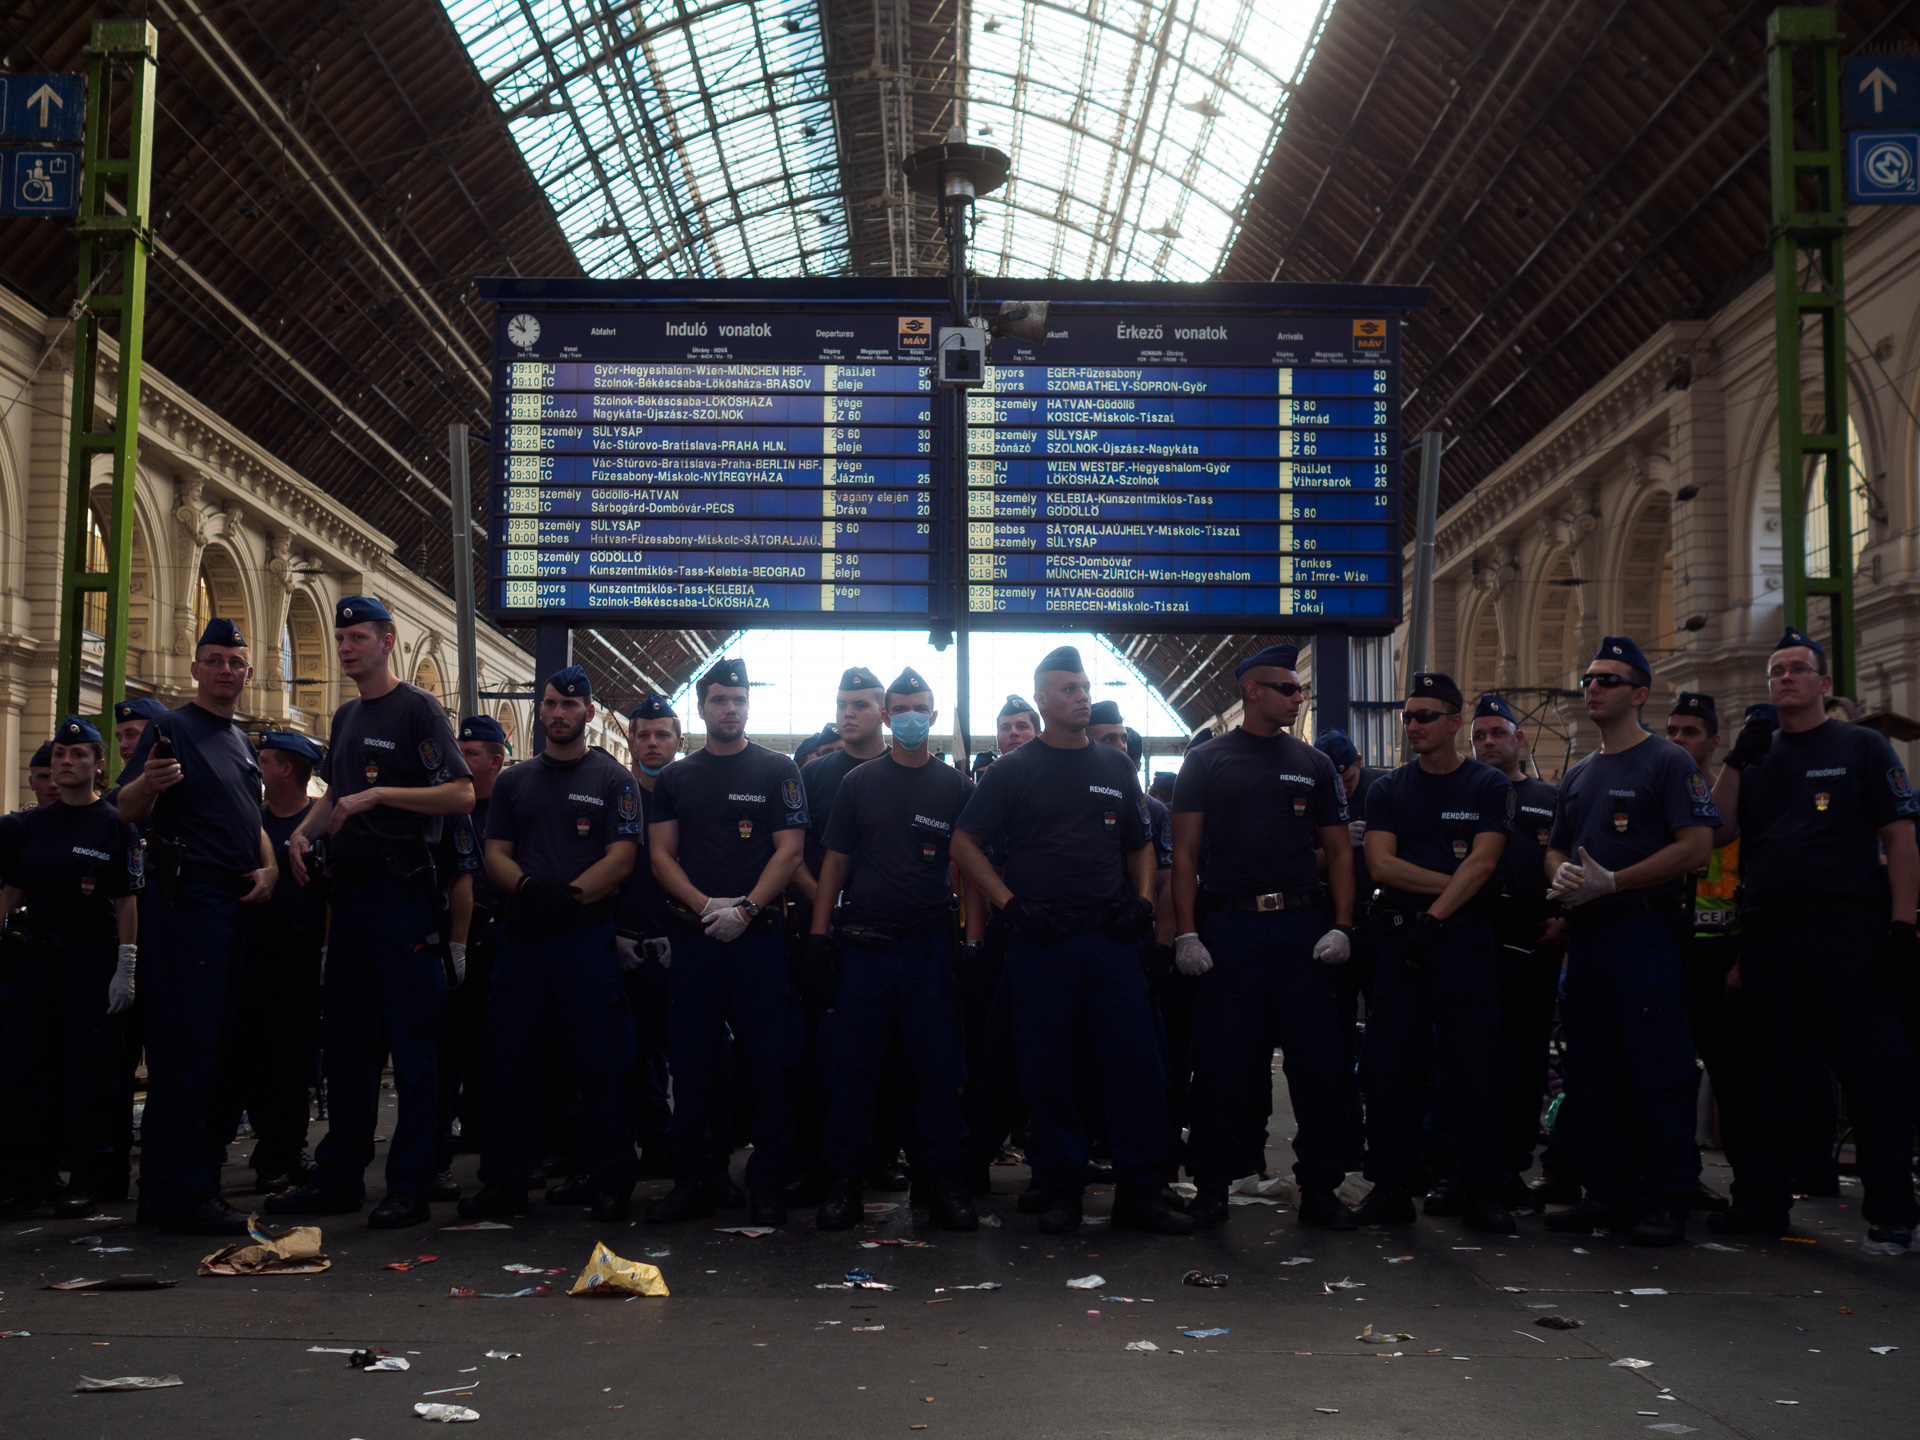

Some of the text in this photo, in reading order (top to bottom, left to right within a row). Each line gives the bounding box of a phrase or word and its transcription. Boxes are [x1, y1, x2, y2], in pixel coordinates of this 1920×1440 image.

[590, 328, 616, 336] Abfahrt
[666, 321, 771, 337] Induló vonatok
[816, 329, 854, 338] Departures
[1174, 326, 1228, 340] vonatok
[903, 336, 927, 345] MÁV
[1277, 332, 1304, 341] Arrivals
[1358, 339, 1382, 348] MÁV
[512, 364, 540, 374] 09:10
[542, 364, 556, 374] RJ
[782, 366, 806, 376] HBF.
[838, 367, 876, 377] RailJet
[994, 369, 1024, 380] gyors
[1046, 368, 1142, 381] EGER-Füzesabony
[1374, 370, 1386, 380] 50
[512, 377, 540, 387] 09:10
[542, 378, 554, 387] IC
[838, 380, 864, 392] eleje
[918, 381, 930, 390] 50
[994, 382, 1024, 393] gyors
[1374, 383, 1386, 393] 40
[511, 395, 862, 411] 09:10 IC vége
[994, 399, 1386, 412] személy S 80 30
[511, 408, 539, 418] 09:15
[542, 408, 576, 419] zónázó
[838, 411, 844, 421] Z
[848, 411, 860, 421] 60
[918, 412, 930, 422] 40
[994, 412, 1008, 422] IC
[1292, 414, 1330, 424] Hernád
[1374, 414, 1386, 424] 20
[511, 425, 930, 440] 09:20 személy SÜLYSÁP S 60 30
[994, 428, 1386, 443] személy SÜLYSÁP S 60 15
[510, 439, 538, 449] 09:25
[540, 439, 554, 449] EC
[762, 441, 786, 451] HLN.
[836, 442, 862, 454] eleje
[918, 442, 930, 452] 30
[994, 443, 1030, 453] zónázó
[1292, 445, 1300, 455] Z
[1304, 445, 1316, 455] 60
[1374, 446, 1386, 456] 15
[510, 457, 538, 468] 09:25
[540, 458, 554, 468] EC
[798, 460, 822, 470] HBF.
[836, 460, 862, 473] vége
[994, 461, 1388, 474] RJ WIEN RailJet 10
[510, 470, 537, 480] 09:30
[540, 471, 552, 480] IC
[836, 473, 874, 483] Jázmin
[918, 474, 930, 483] 25
[994, 474, 1386, 487] IC Viharsarok 25
[509, 488, 930, 504] 09:35 személy vágány elején 25
[994, 492, 1036, 505] személy
[1374, 495, 1388, 505] 10
[509, 502, 537, 512] 09:45
[540, 502, 552, 512] IC
[836, 504, 866, 514] Dráva
[918, 505, 930, 515] 20
[994, 506, 1036, 518] személy
[1292, 508, 1300, 518] S
[1304, 508, 1316, 518] 80
[508, 518, 930, 533] 09:50 személy SÜLYSÁP S 60 20
[994, 524, 1026, 534] sebes
[508, 533, 536, 543] 10:00
[538, 533, 570, 543] sebes
[994, 536, 1316, 550] személy SÜLYSÁP S 60
[508, 551, 536, 561] 10:05
[538, 552, 580, 564] személy
[836, 554, 842, 564] S
[846, 554, 858, 564] 80
[994, 554, 1332, 568] IC PÉCS-Dombóvár Tenkes
[507, 564, 535, 574] 10:05
[538, 567, 566, 577] gyors
[836, 567, 860, 580] eleje
[994, 569, 1008, 579] EN
[1294, 571, 1308, 581] án
[1312, 571, 1340, 581] Imre-
[507, 582, 535, 593] 10:05
[536, 584, 566, 596] gyors
[836, 585, 860, 598] vége
[994, 587, 1316, 600] személy S 80
[507, 596, 566, 609] 10:10 gyors
[994, 600, 1006, 610] IC
[1294, 602, 1324, 615] Tokaj
